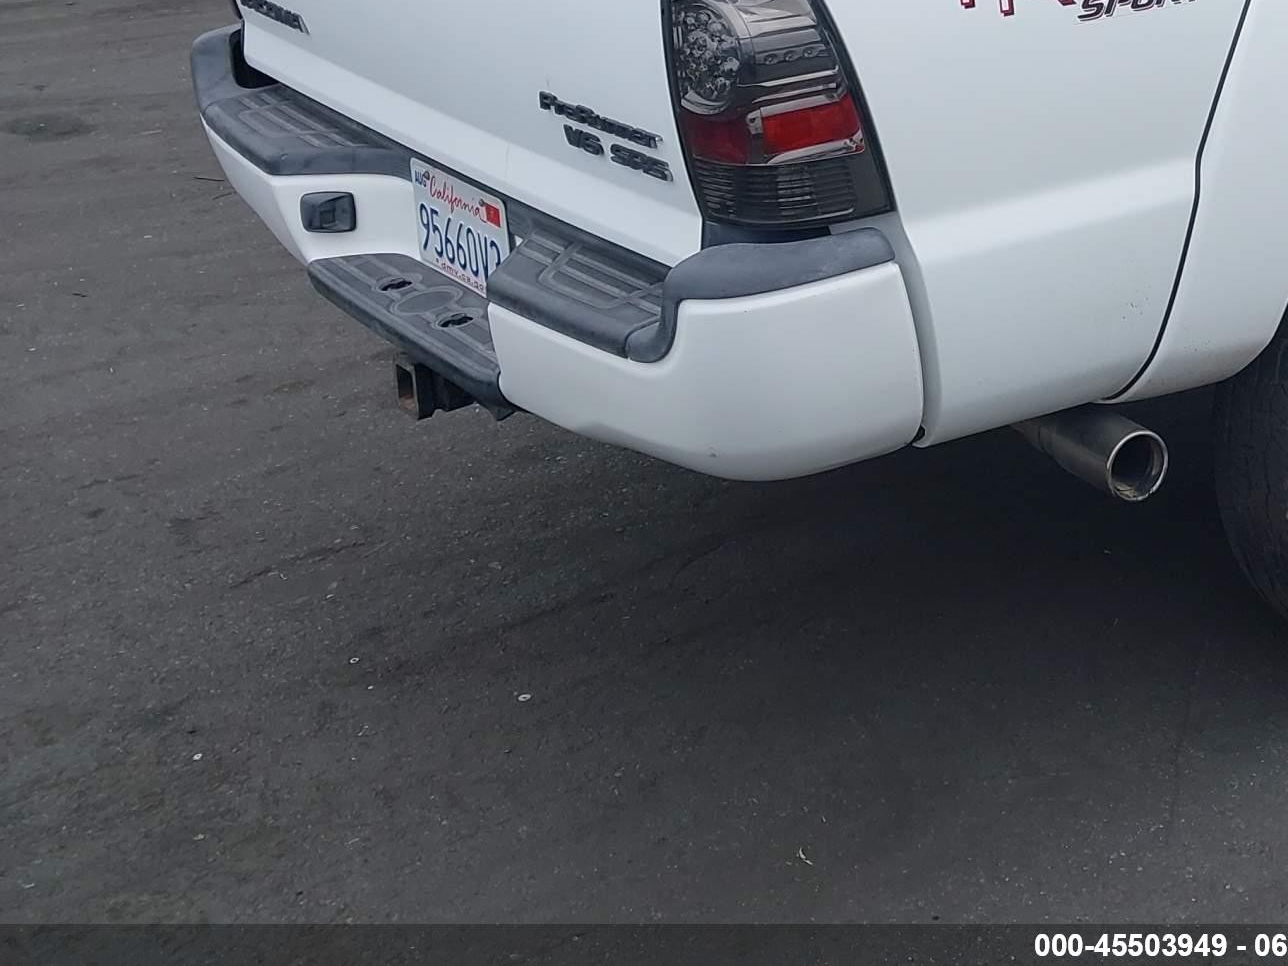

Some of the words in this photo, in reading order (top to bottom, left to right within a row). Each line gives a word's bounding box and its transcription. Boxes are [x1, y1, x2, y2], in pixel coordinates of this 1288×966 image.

[563, 123, 605, 156] V6
[429, 174, 487, 223] California
[441, 261, 486, 292] dmv.ca.go
